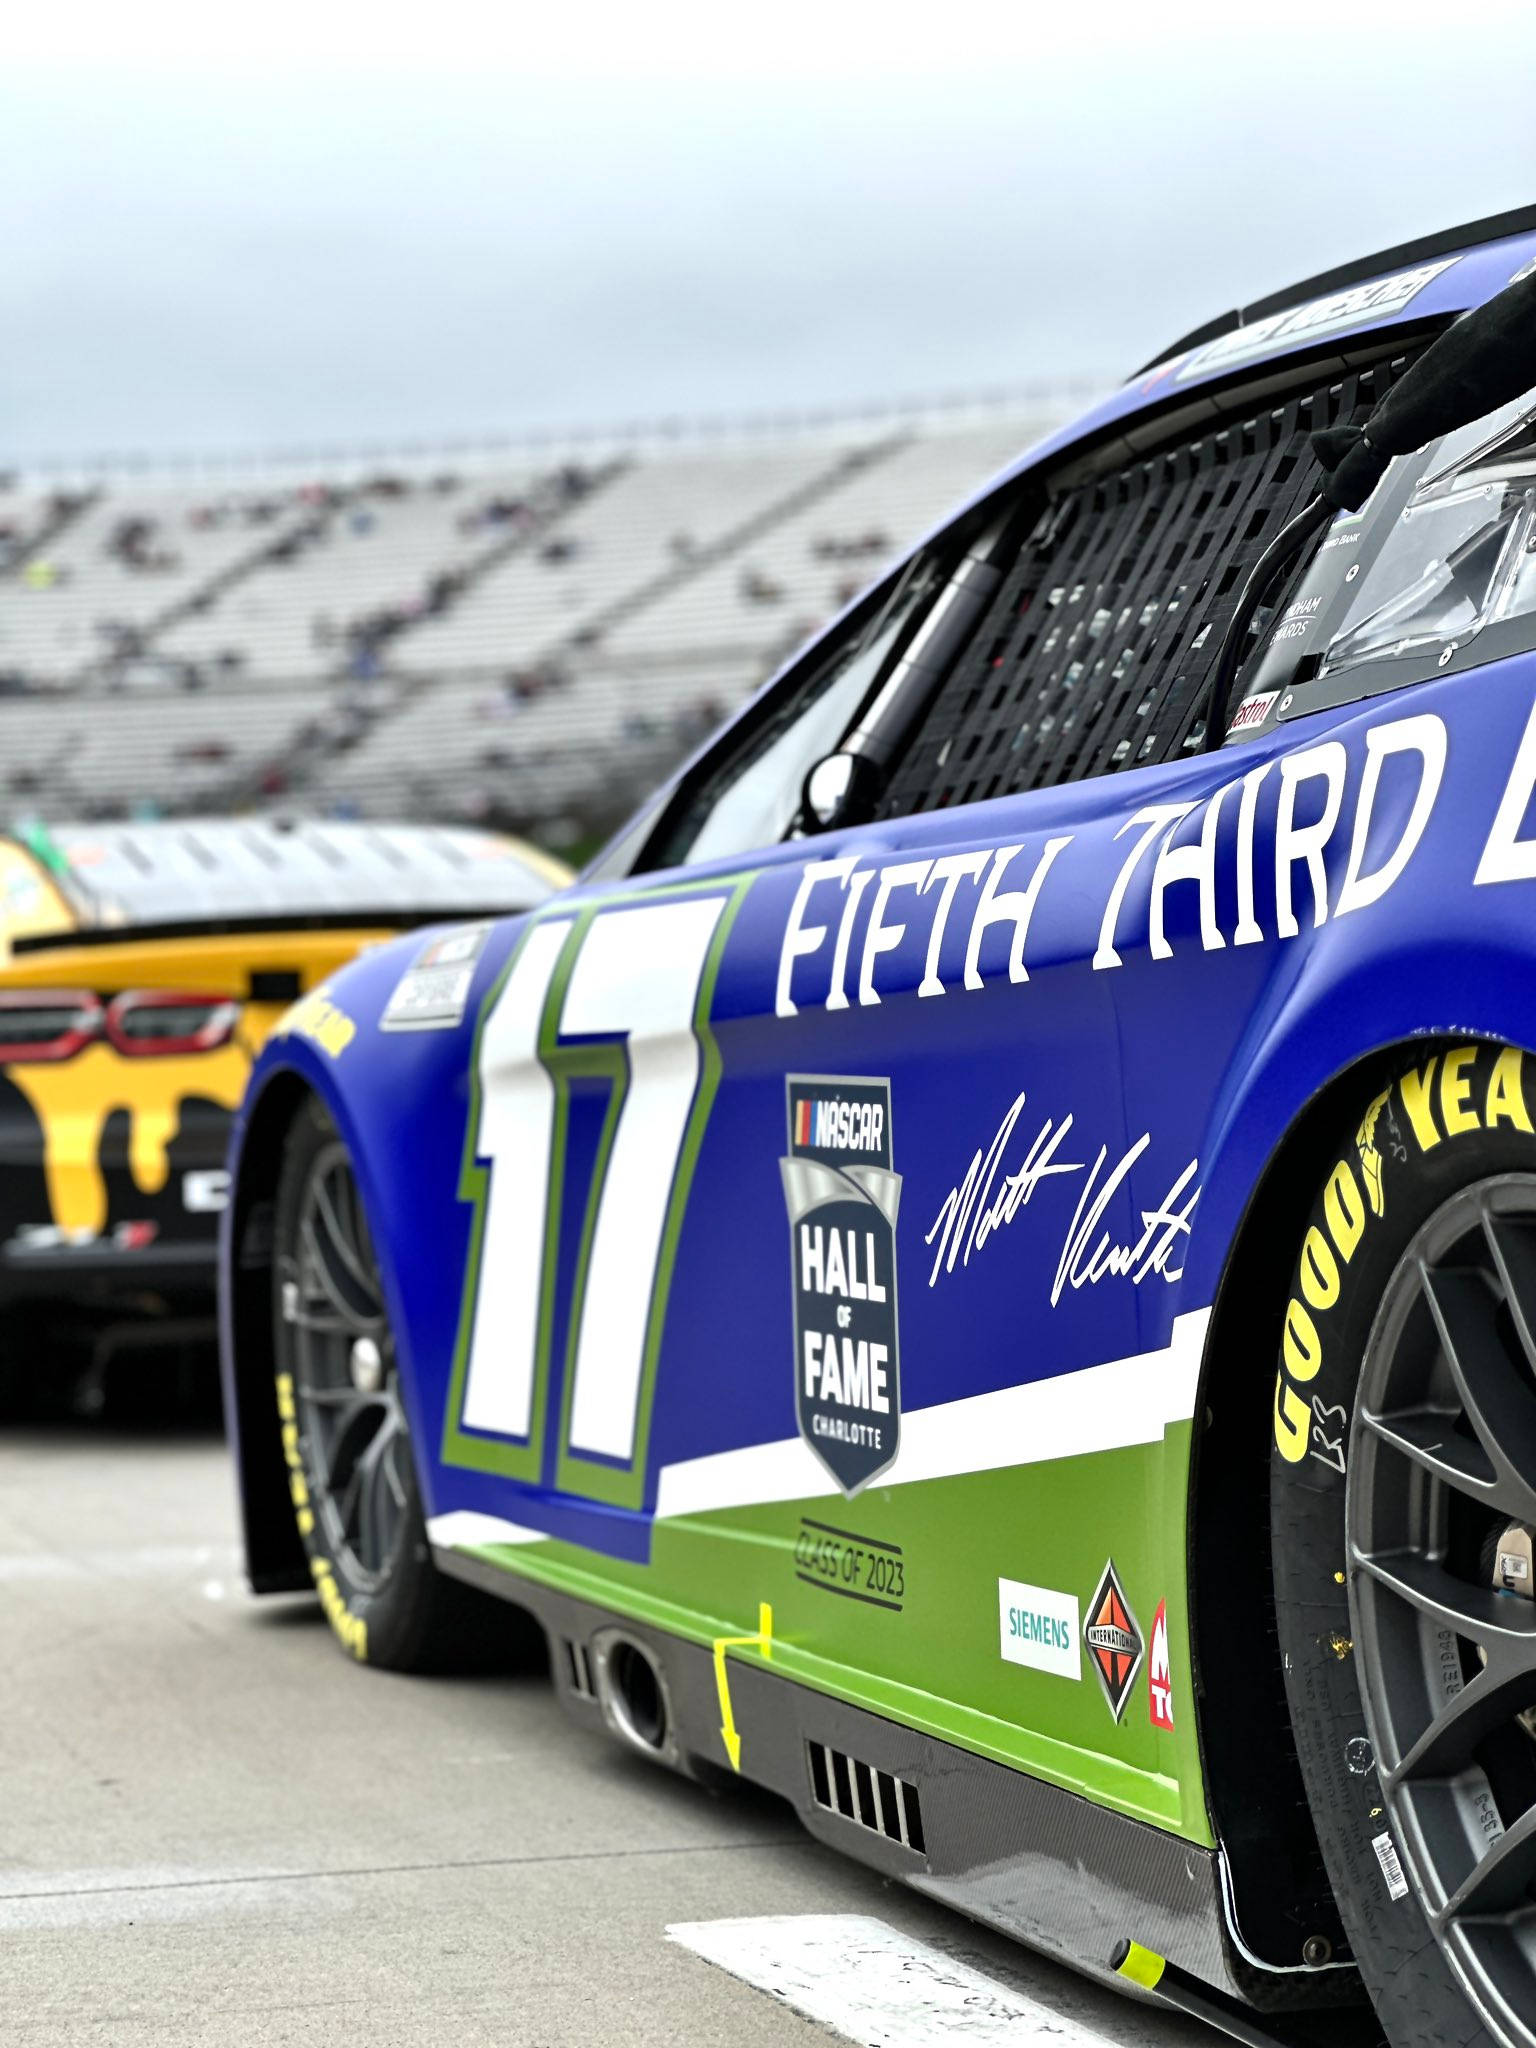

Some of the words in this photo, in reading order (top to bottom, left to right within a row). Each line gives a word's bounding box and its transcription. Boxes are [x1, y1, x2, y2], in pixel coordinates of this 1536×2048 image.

[775, 834, 1075, 1018] FIFTH
[1092, 713, 1449, 971] THIRD
[814, 1100, 883, 1151] NASCAR
[450, 892, 735, 1486] 17
[925, 1091, 1086, 1288] Matt
[801, 1223, 887, 1304] HALL
[836, 1304, 852, 1329] OF
[804, 1329, 890, 1415] FAME
[812, 1414, 882, 1450] CHARLOTTE
[794, 1531, 840, 1578] CLASS
[842, 1546, 864, 1585] OF
[866, 1553, 905, 1597] 2023
[1009, 1607, 1070, 1650] SIEMENS
[1090, 1629, 1135, 1648] INTERNATIONA
